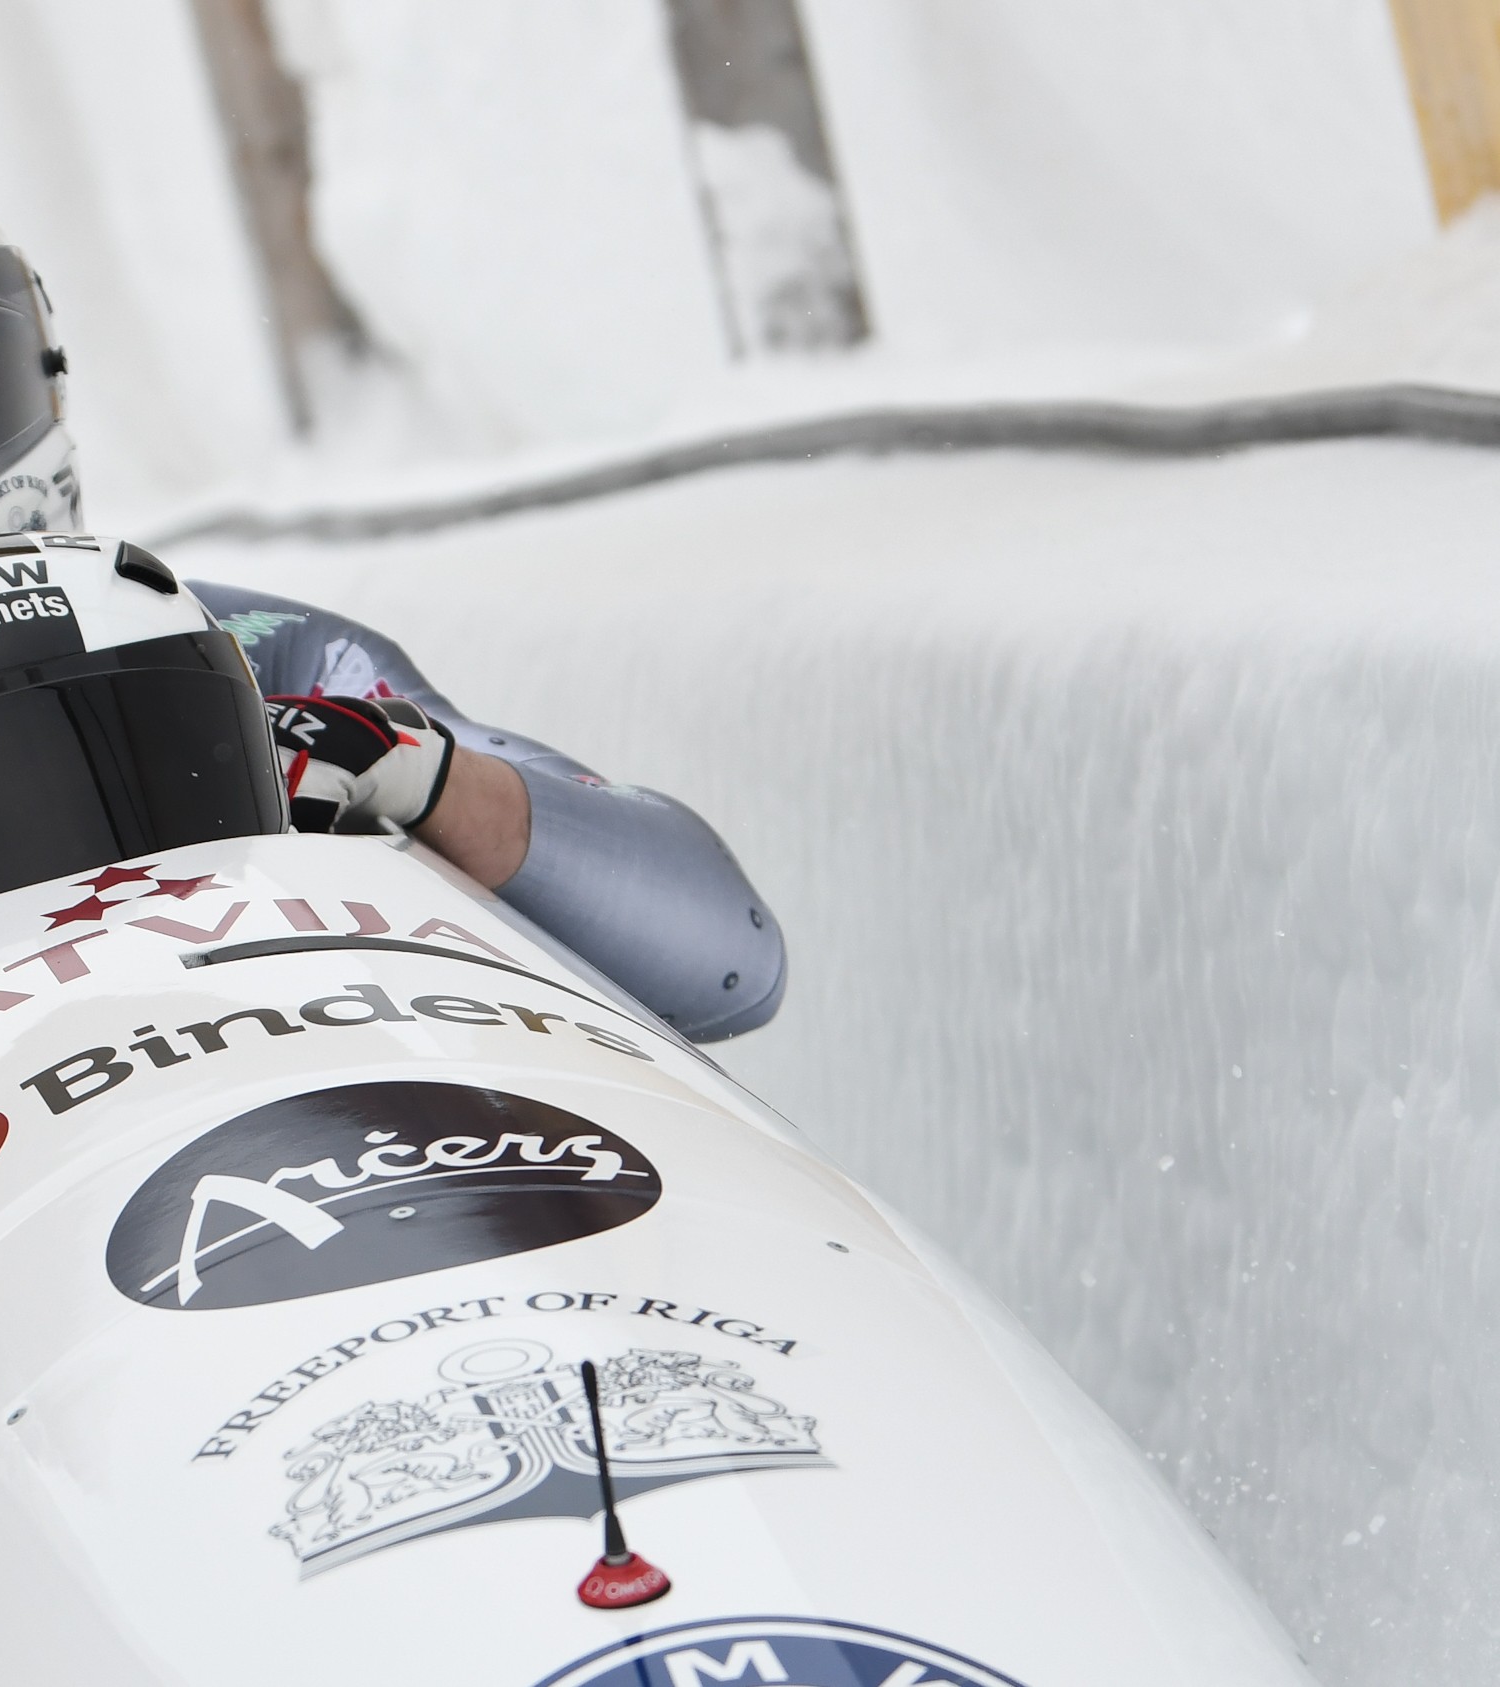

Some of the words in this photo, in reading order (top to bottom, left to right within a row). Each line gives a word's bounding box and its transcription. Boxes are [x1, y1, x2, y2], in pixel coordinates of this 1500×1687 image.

[264, 702, 327, 746] EIZ
[19, 983, 656, 1116] Binders
[190, 1296, 506, 1462] FREEPORT
[526, 1291, 618, 1312] OF
[630, 1296, 798, 1357] RIGA
